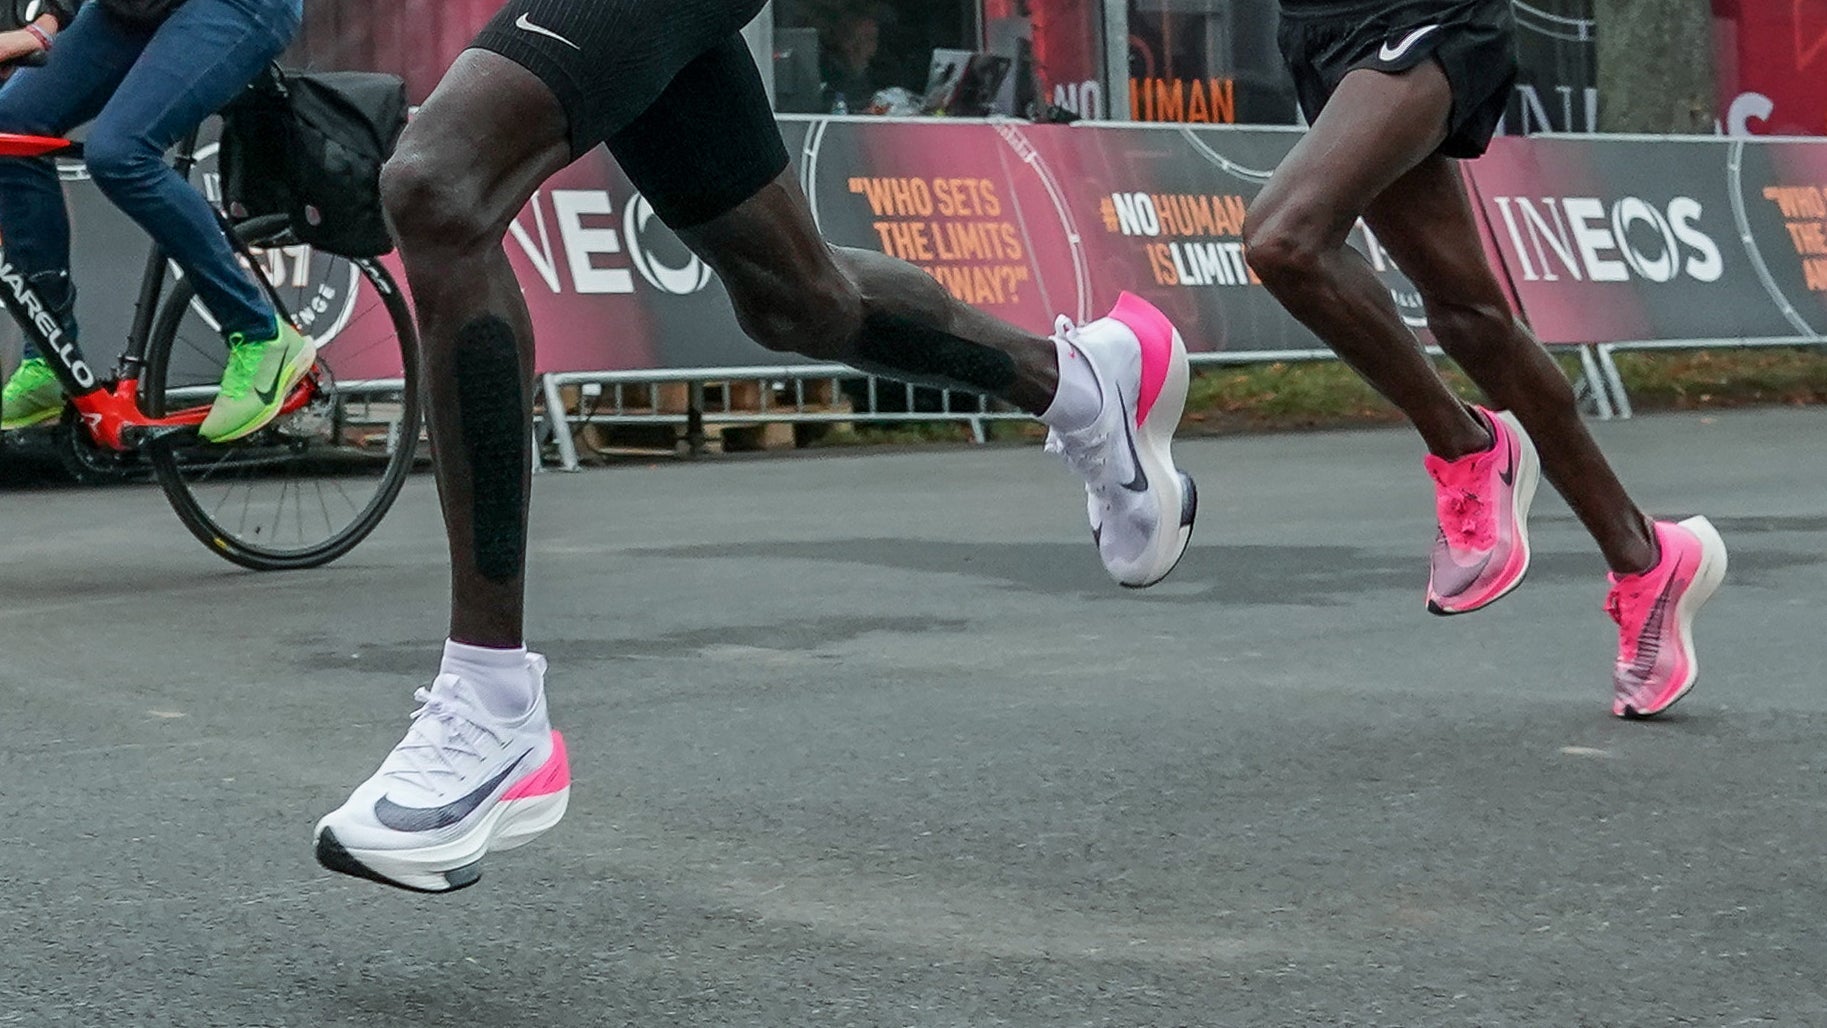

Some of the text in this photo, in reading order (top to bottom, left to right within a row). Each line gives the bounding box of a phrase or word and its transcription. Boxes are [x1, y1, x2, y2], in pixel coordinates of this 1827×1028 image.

[933, 177, 1001, 217] SETS
[1100, 192, 1246, 236] #NOHUMAN
[873, 221, 1022, 260] THE LIMITS
[1494, 196, 1723, 282] INEOS
